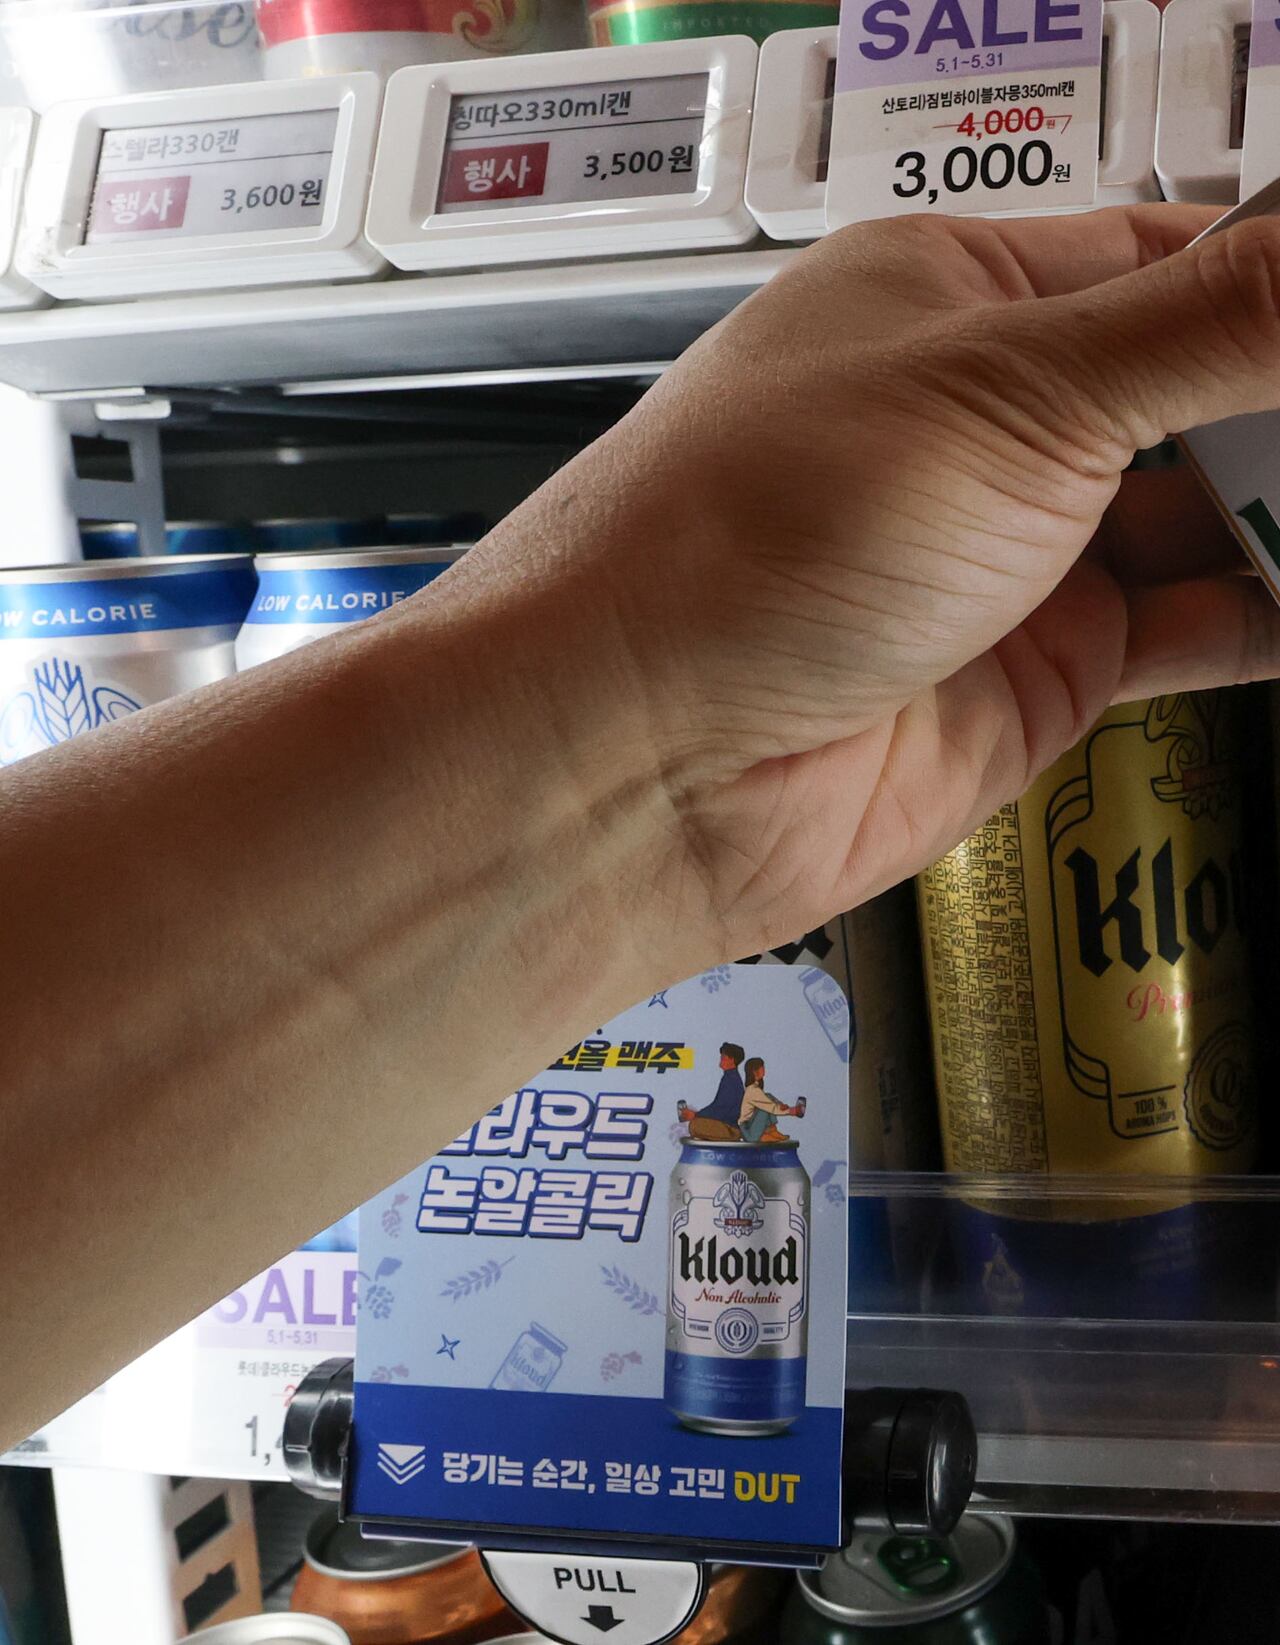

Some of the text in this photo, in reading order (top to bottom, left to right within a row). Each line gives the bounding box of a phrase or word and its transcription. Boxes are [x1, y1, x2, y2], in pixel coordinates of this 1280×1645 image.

[103, 129, 240, 162] 스텔라330캔
[463, 145, 694, 193] 행사 3,500원
[893, 140, 1071, 204] 3,000원
[106, 179, 323, 225] 행사 3,600원
[37, 603, 157, 626] CALORIE
[256, 595, 292, 612] LOW
[616, 1040, 686, 1074] 맥주
[416, 1165, 656, 1243] 논알콜릭
[679, 1231, 799, 1286] kloud
[695, 1287, 782, 1305] Non Alcoholic
[442, 1452, 802, 1504] 당기는 순간, 일상 고민 OUT
[553, 1566, 637, 1595] PULL
